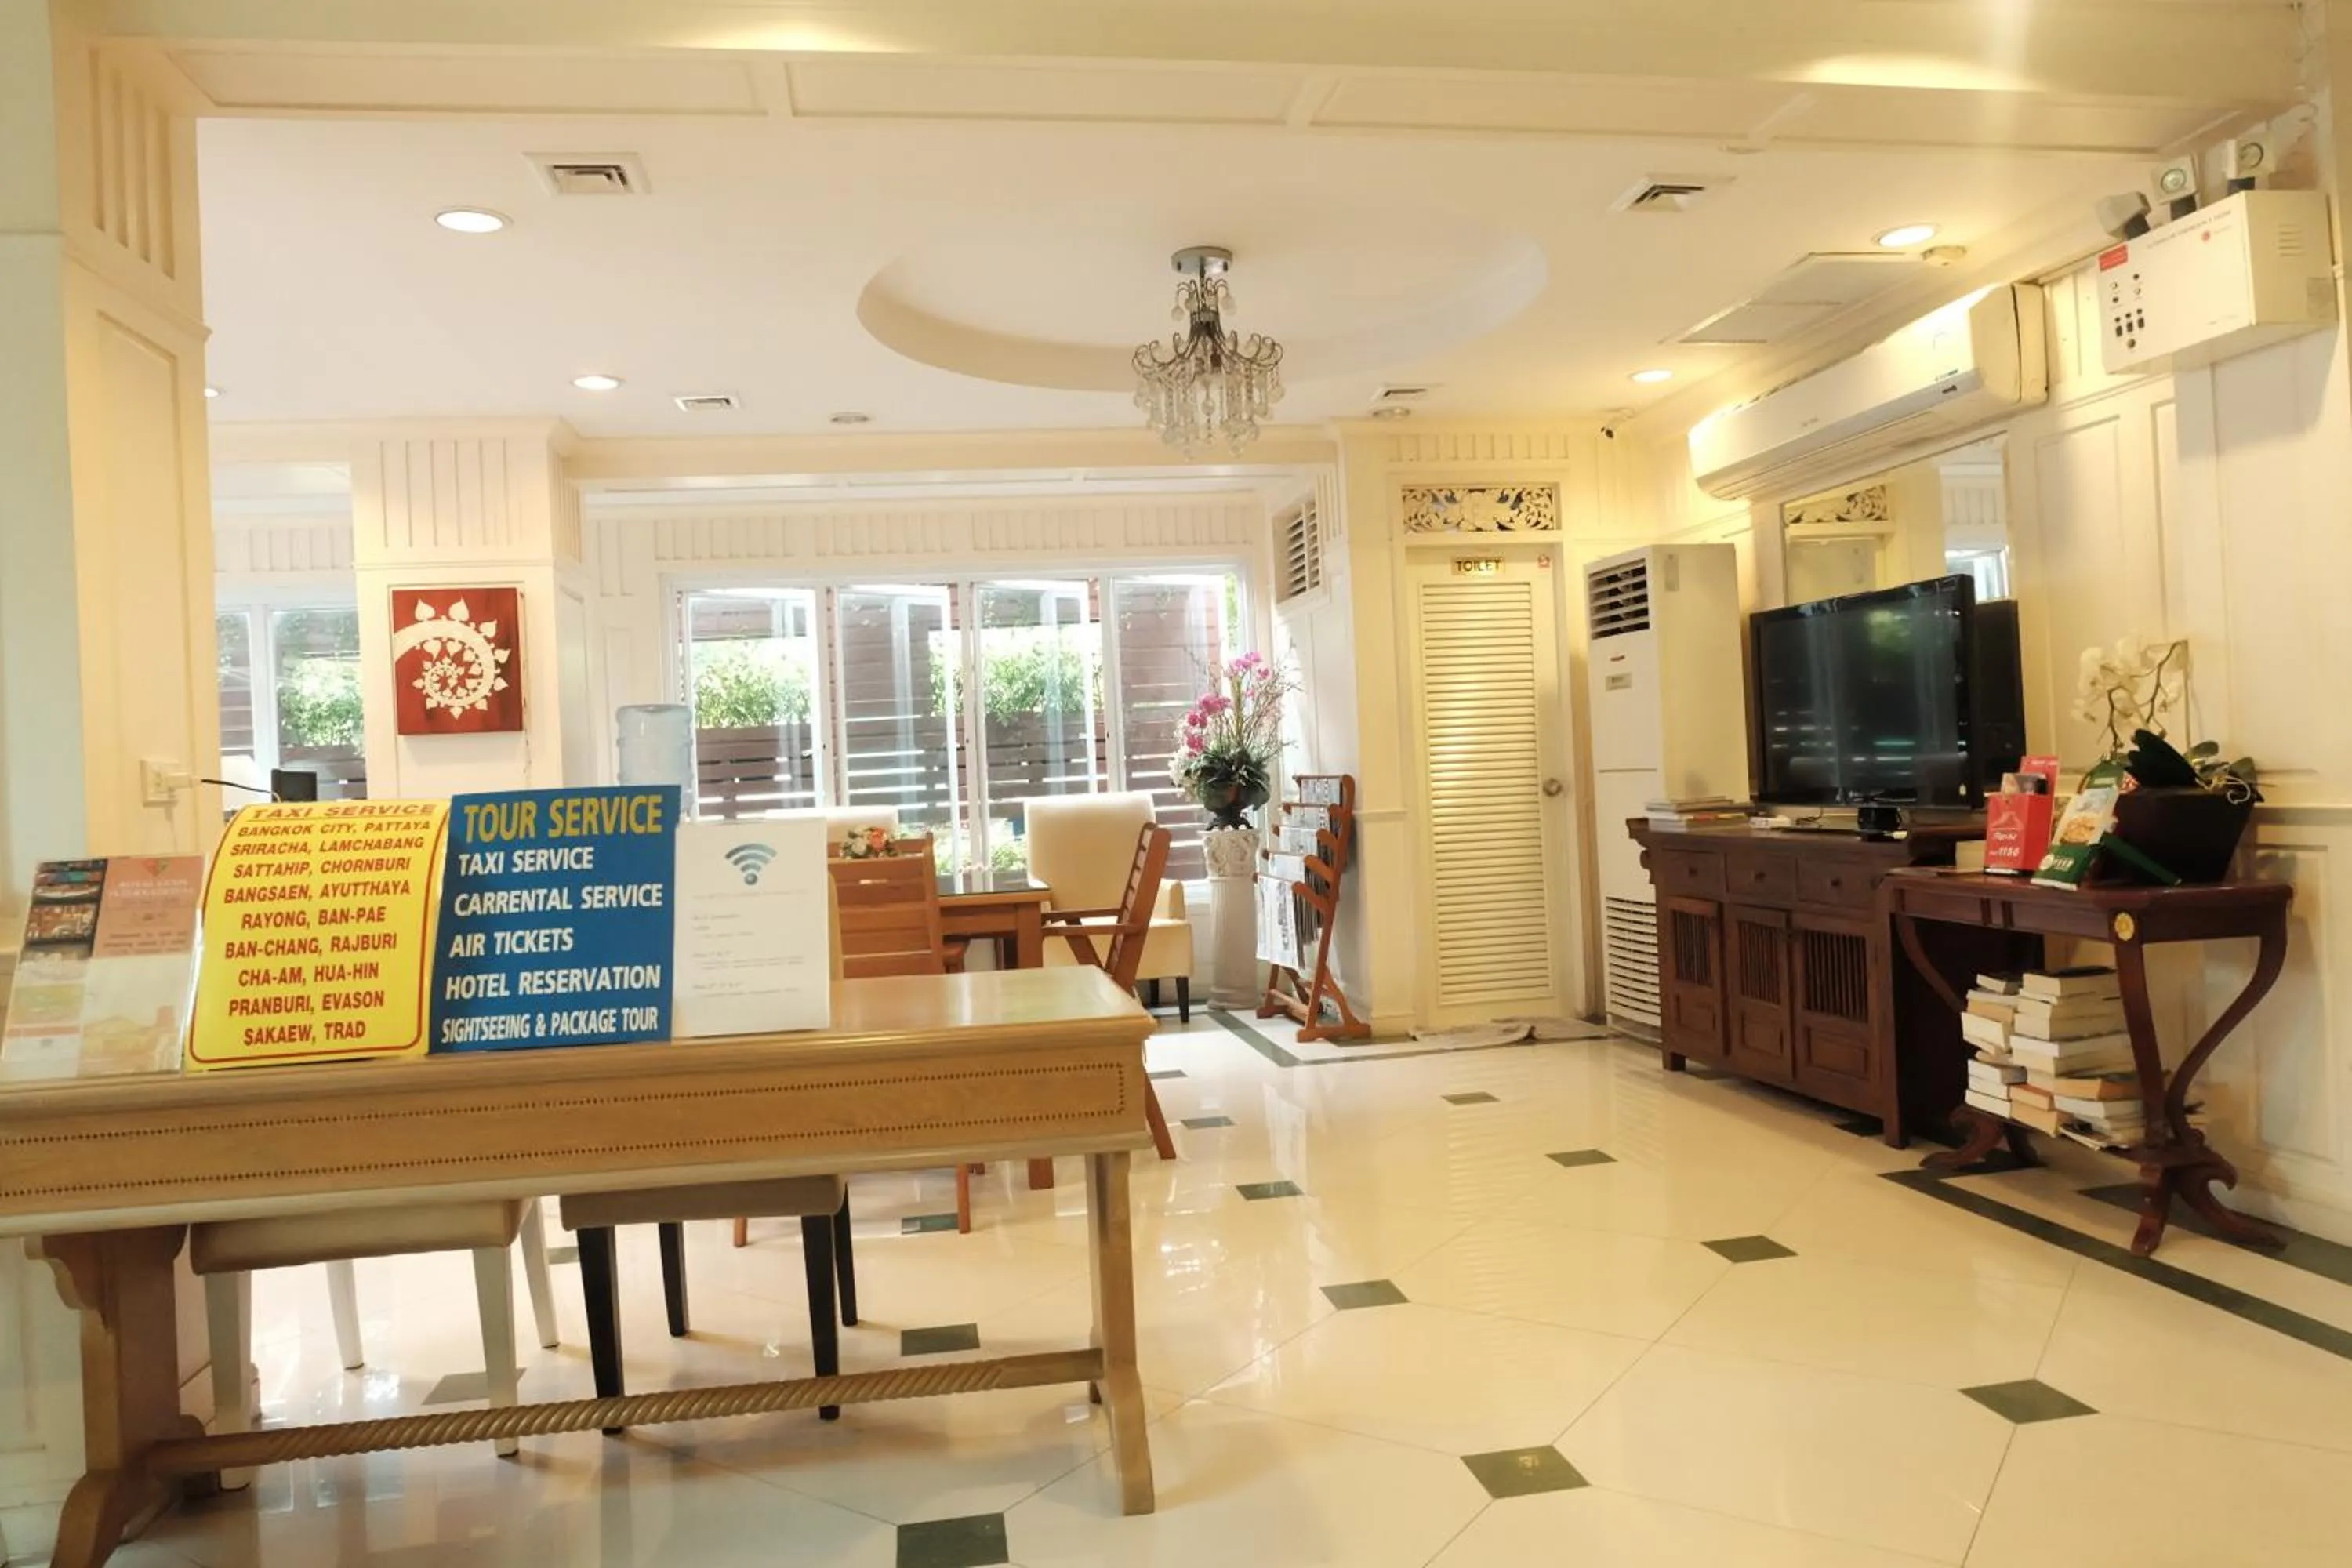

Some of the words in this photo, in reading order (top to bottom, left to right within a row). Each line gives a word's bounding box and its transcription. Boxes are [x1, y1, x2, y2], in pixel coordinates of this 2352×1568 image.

[1456, 559, 1501, 572] TOILET
[253, 807, 313, 818] TAXI
[324, 804, 437, 816] SERVICE
[463, 800, 537, 844] TOUR
[548, 794, 662, 838] SERVICE
[238, 824, 313, 837] BANGKOK
[320, 823, 357, 834] CITY,
[364, 821, 430, 832] PATTAYA
[230, 840, 312, 856] SRIRACHA,
[318, 837, 424, 852] LAMCHABANG
[233, 862, 313, 878] SATTAHIP,
[320, 857, 411, 873] CHORNBURI
[458, 851, 505, 877] TAXI
[511, 847, 594, 873] SERVICE
[224, 884, 312, 903] BANGSAEN,
[320, 880, 410, 898] AYUTTHAYA
[454, 887, 572, 916] CARRENTAL
[580, 884, 663, 909] SERVICE
[241, 910, 311, 930] RAYONG,
[318, 906, 386, 925] BAN-PAE
[225, 938, 322, 959] BAN-CHANG,
[330, 933, 397, 953] RAJBURI
[448, 932, 485, 958] AIR
[493, 927, 574, 956] TICKETS
[238, 967, 307, 986] CHA-AM,
[314, 962, 379, 982] HUA-HIN
[445, 973, 510, 1000] HOTEL
[518, 965, 661, 996] RESERVATION
[229, 995, 314, 1016] PRANBURI,
[322, 990, 384, 1010] EVASON
[243, 1024, 316, 1046] SAKAEW,
[324, 1021, 365, 1040] TRAD
[441, 1014, 531, 1044] SIGHTSEEING
[535, 1014, 546, 1037] &
[550, 1009, 617, 1036] PACKAGE
[622, 1007, 659, 1031] TOUR
